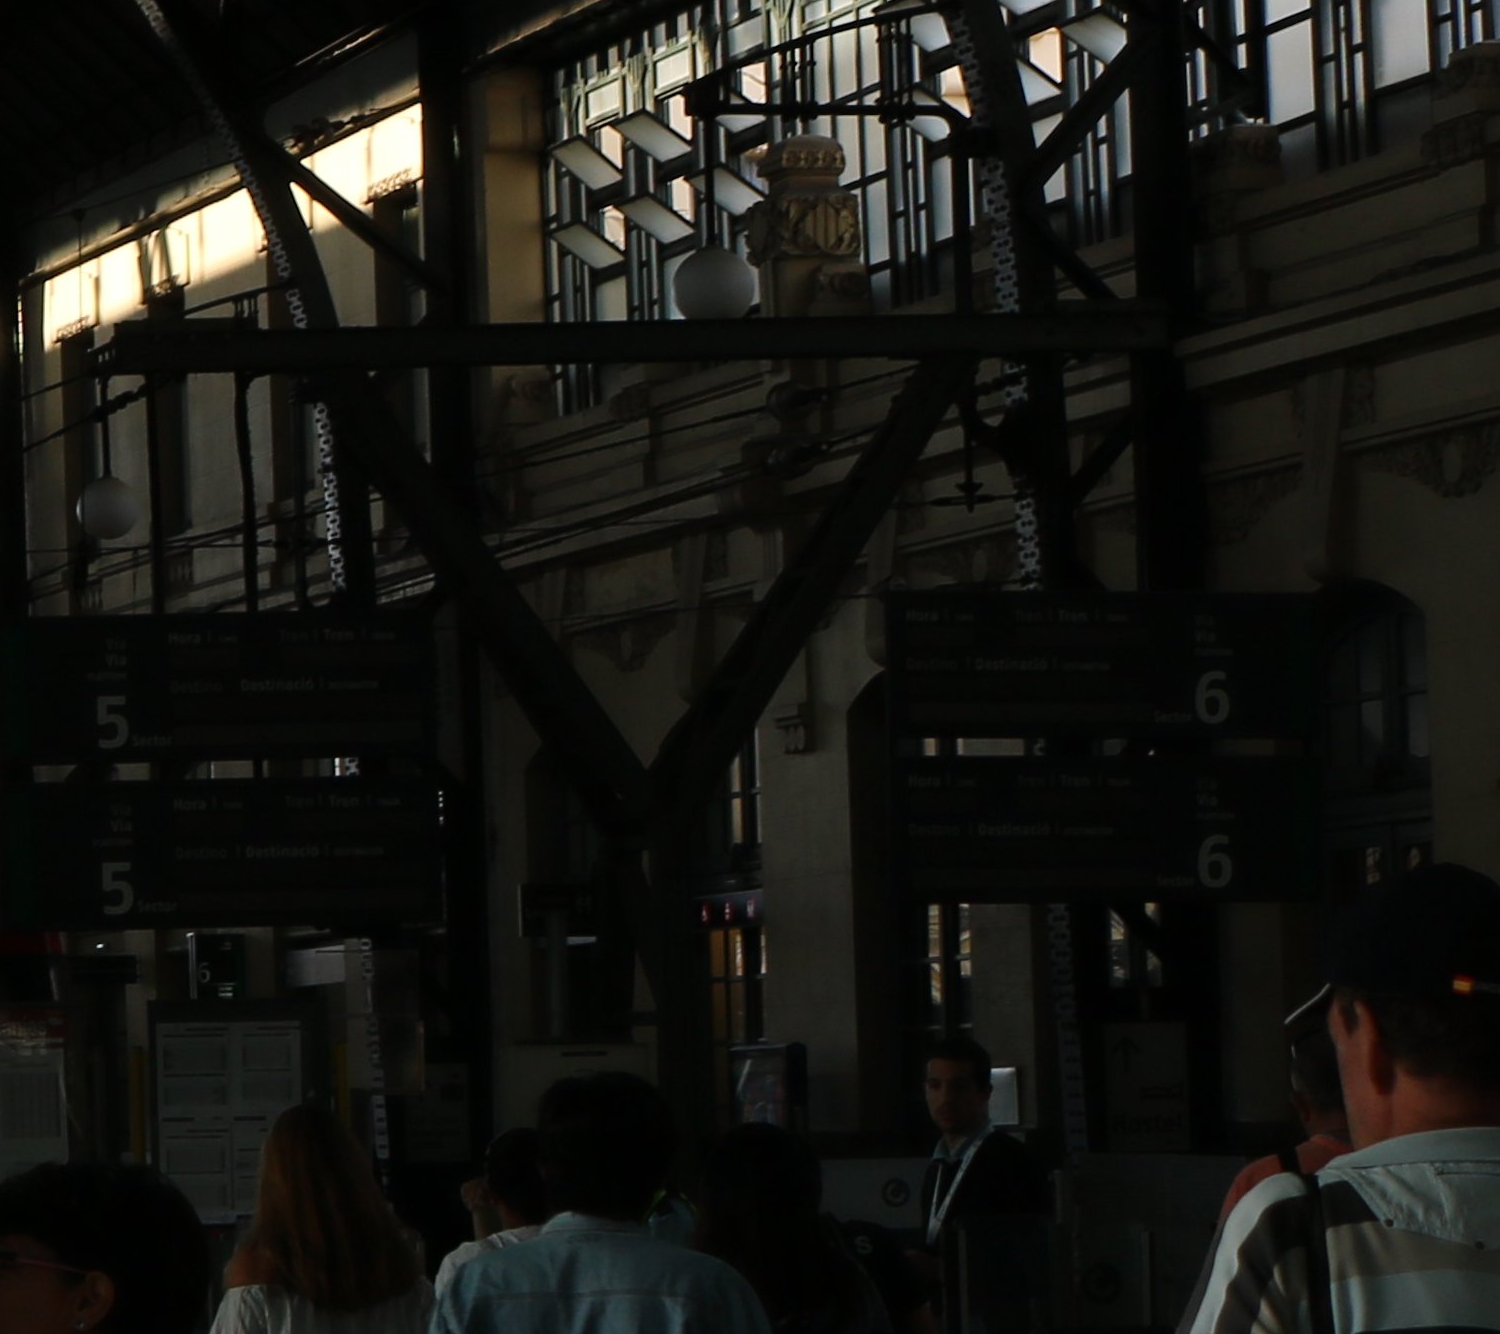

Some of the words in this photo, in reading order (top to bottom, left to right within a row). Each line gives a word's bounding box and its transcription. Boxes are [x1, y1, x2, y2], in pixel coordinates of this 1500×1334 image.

[96, 695, 130, 749] 5
[1194, 670, 1230, 724] 6
[101, 861, 135, 916] 5
[1197, 835, 1232, 889] 6
